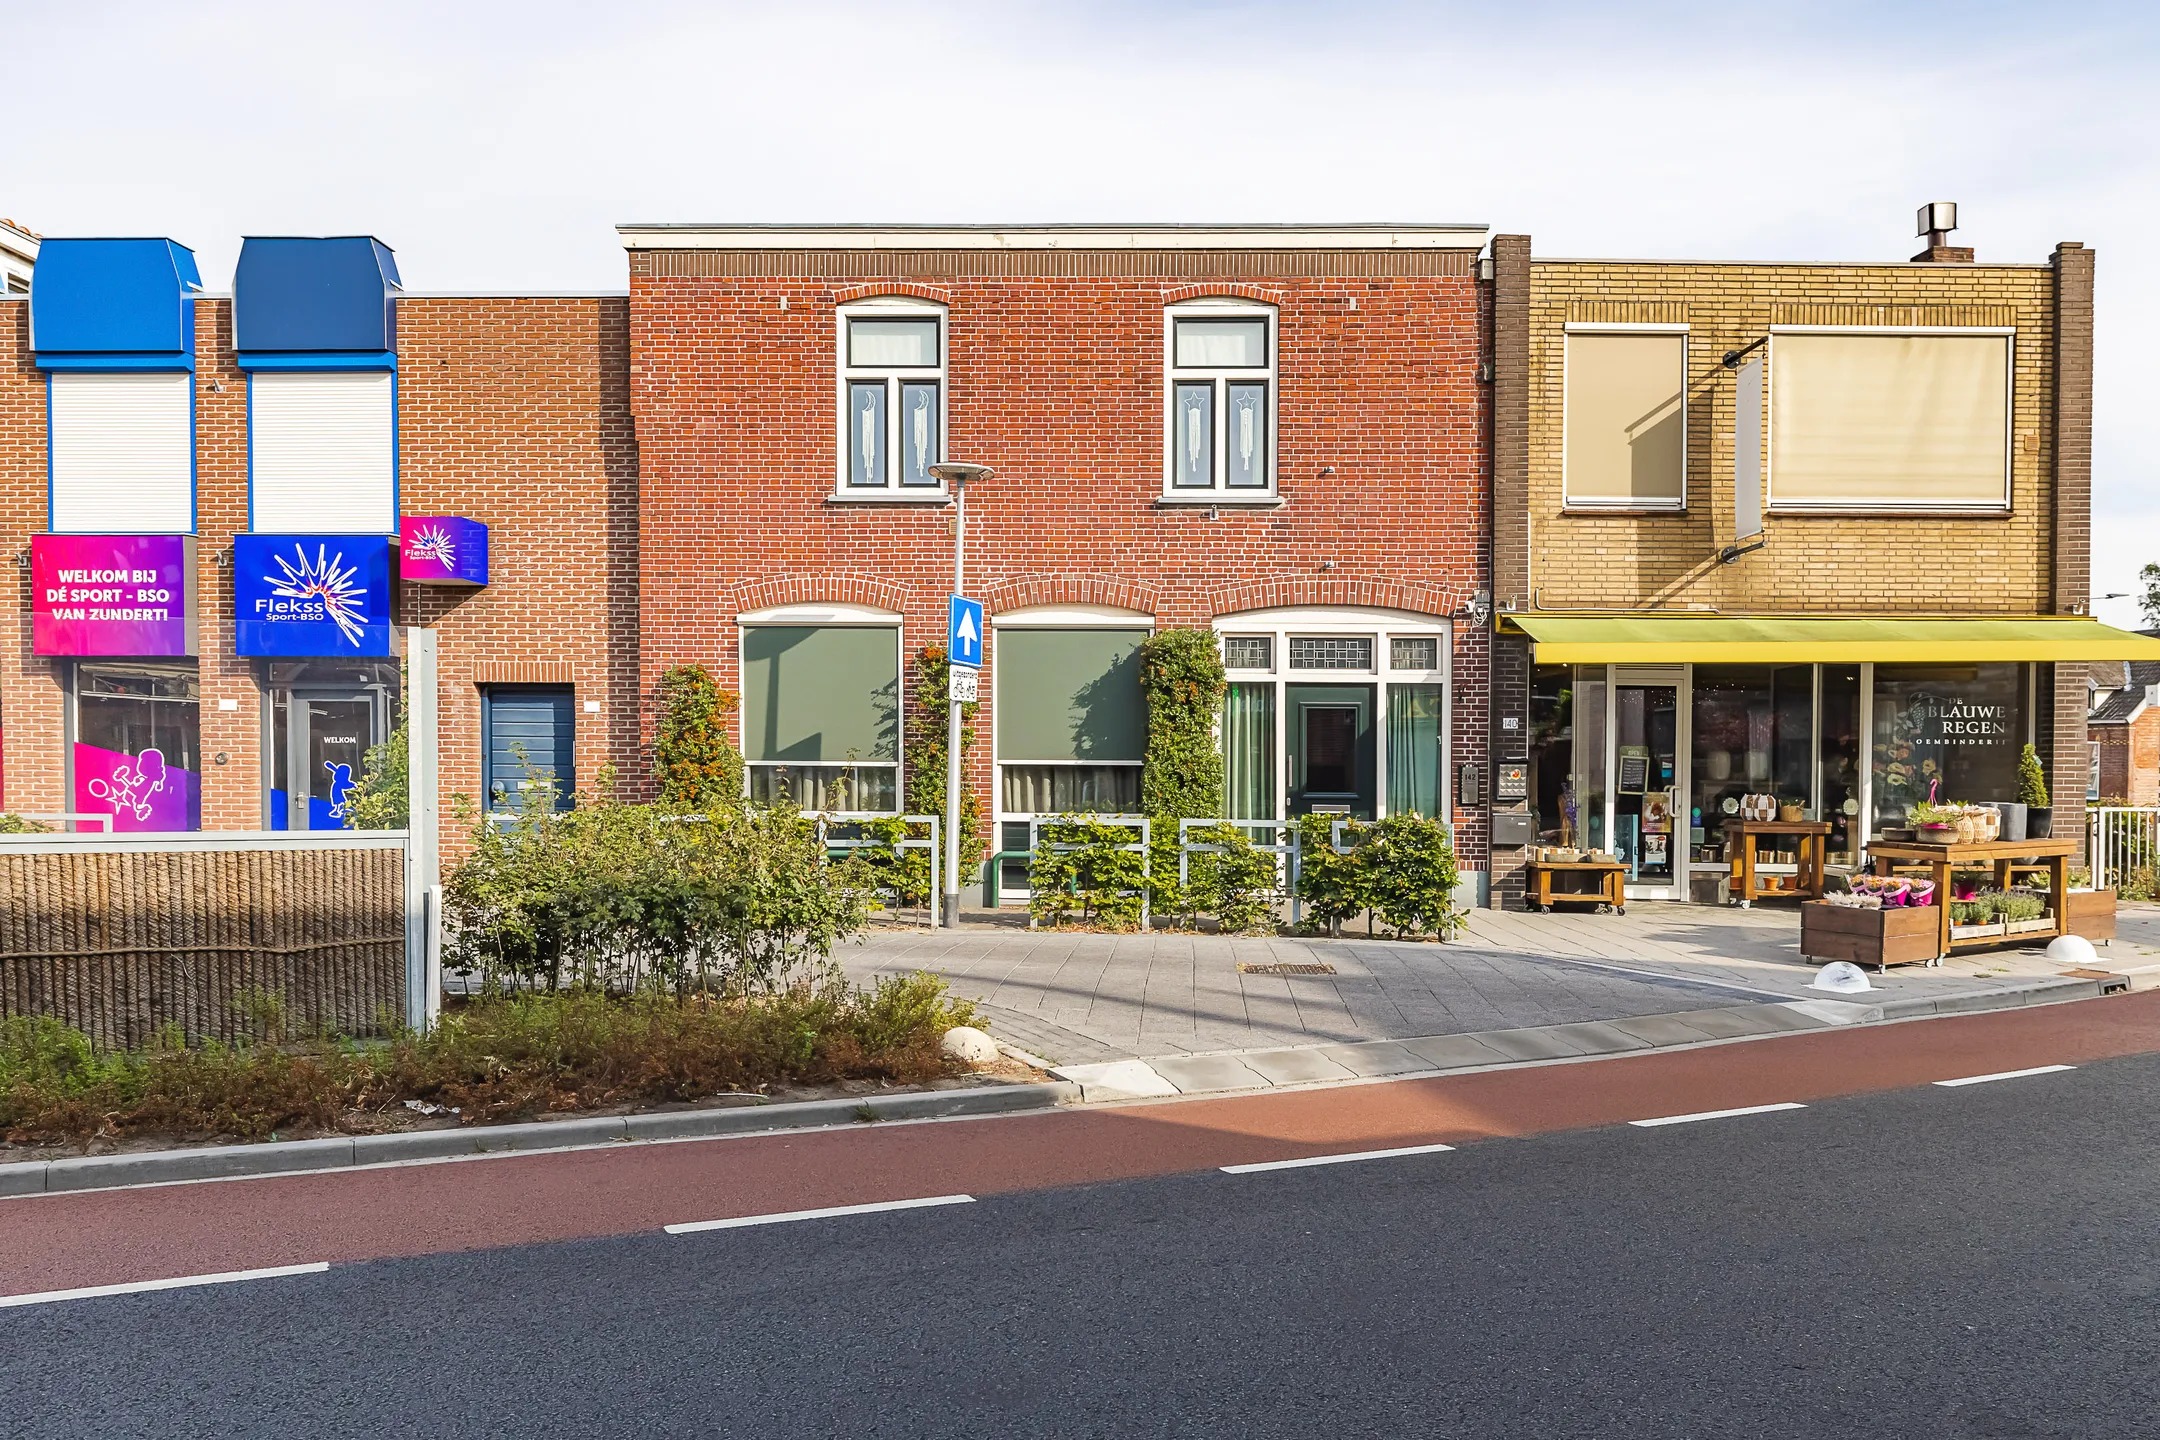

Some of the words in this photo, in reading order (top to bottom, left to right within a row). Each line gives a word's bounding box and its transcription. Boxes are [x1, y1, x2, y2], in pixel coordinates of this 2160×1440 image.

[405, 549, 436, 557] Flekss
[58, 569, 128, 583] WELKOM
[132, 569, 157, 583] BIJ
[46, 586, 67, 602] DÉ
[70, 588, 123, 602] SPORT
[137, 588, 170, 602] BSO
[255, 599, 324, 613] Flekss
[52, 608, 85, 620] VAN
[89, 608, 168, 621] ZUNDERT!
[266, 613, 324, 622] Sport-BSO
[1949, 697, 1963, 705] DE
[1928, 705, 2006, 718] BLAUWE
[1503, 719, 1518, 729] 140
[1942, 721, 2005, 734] REGEN
[323, 736, 357, 744] WELKOM
[1465, 773, 1476, 781] 142
